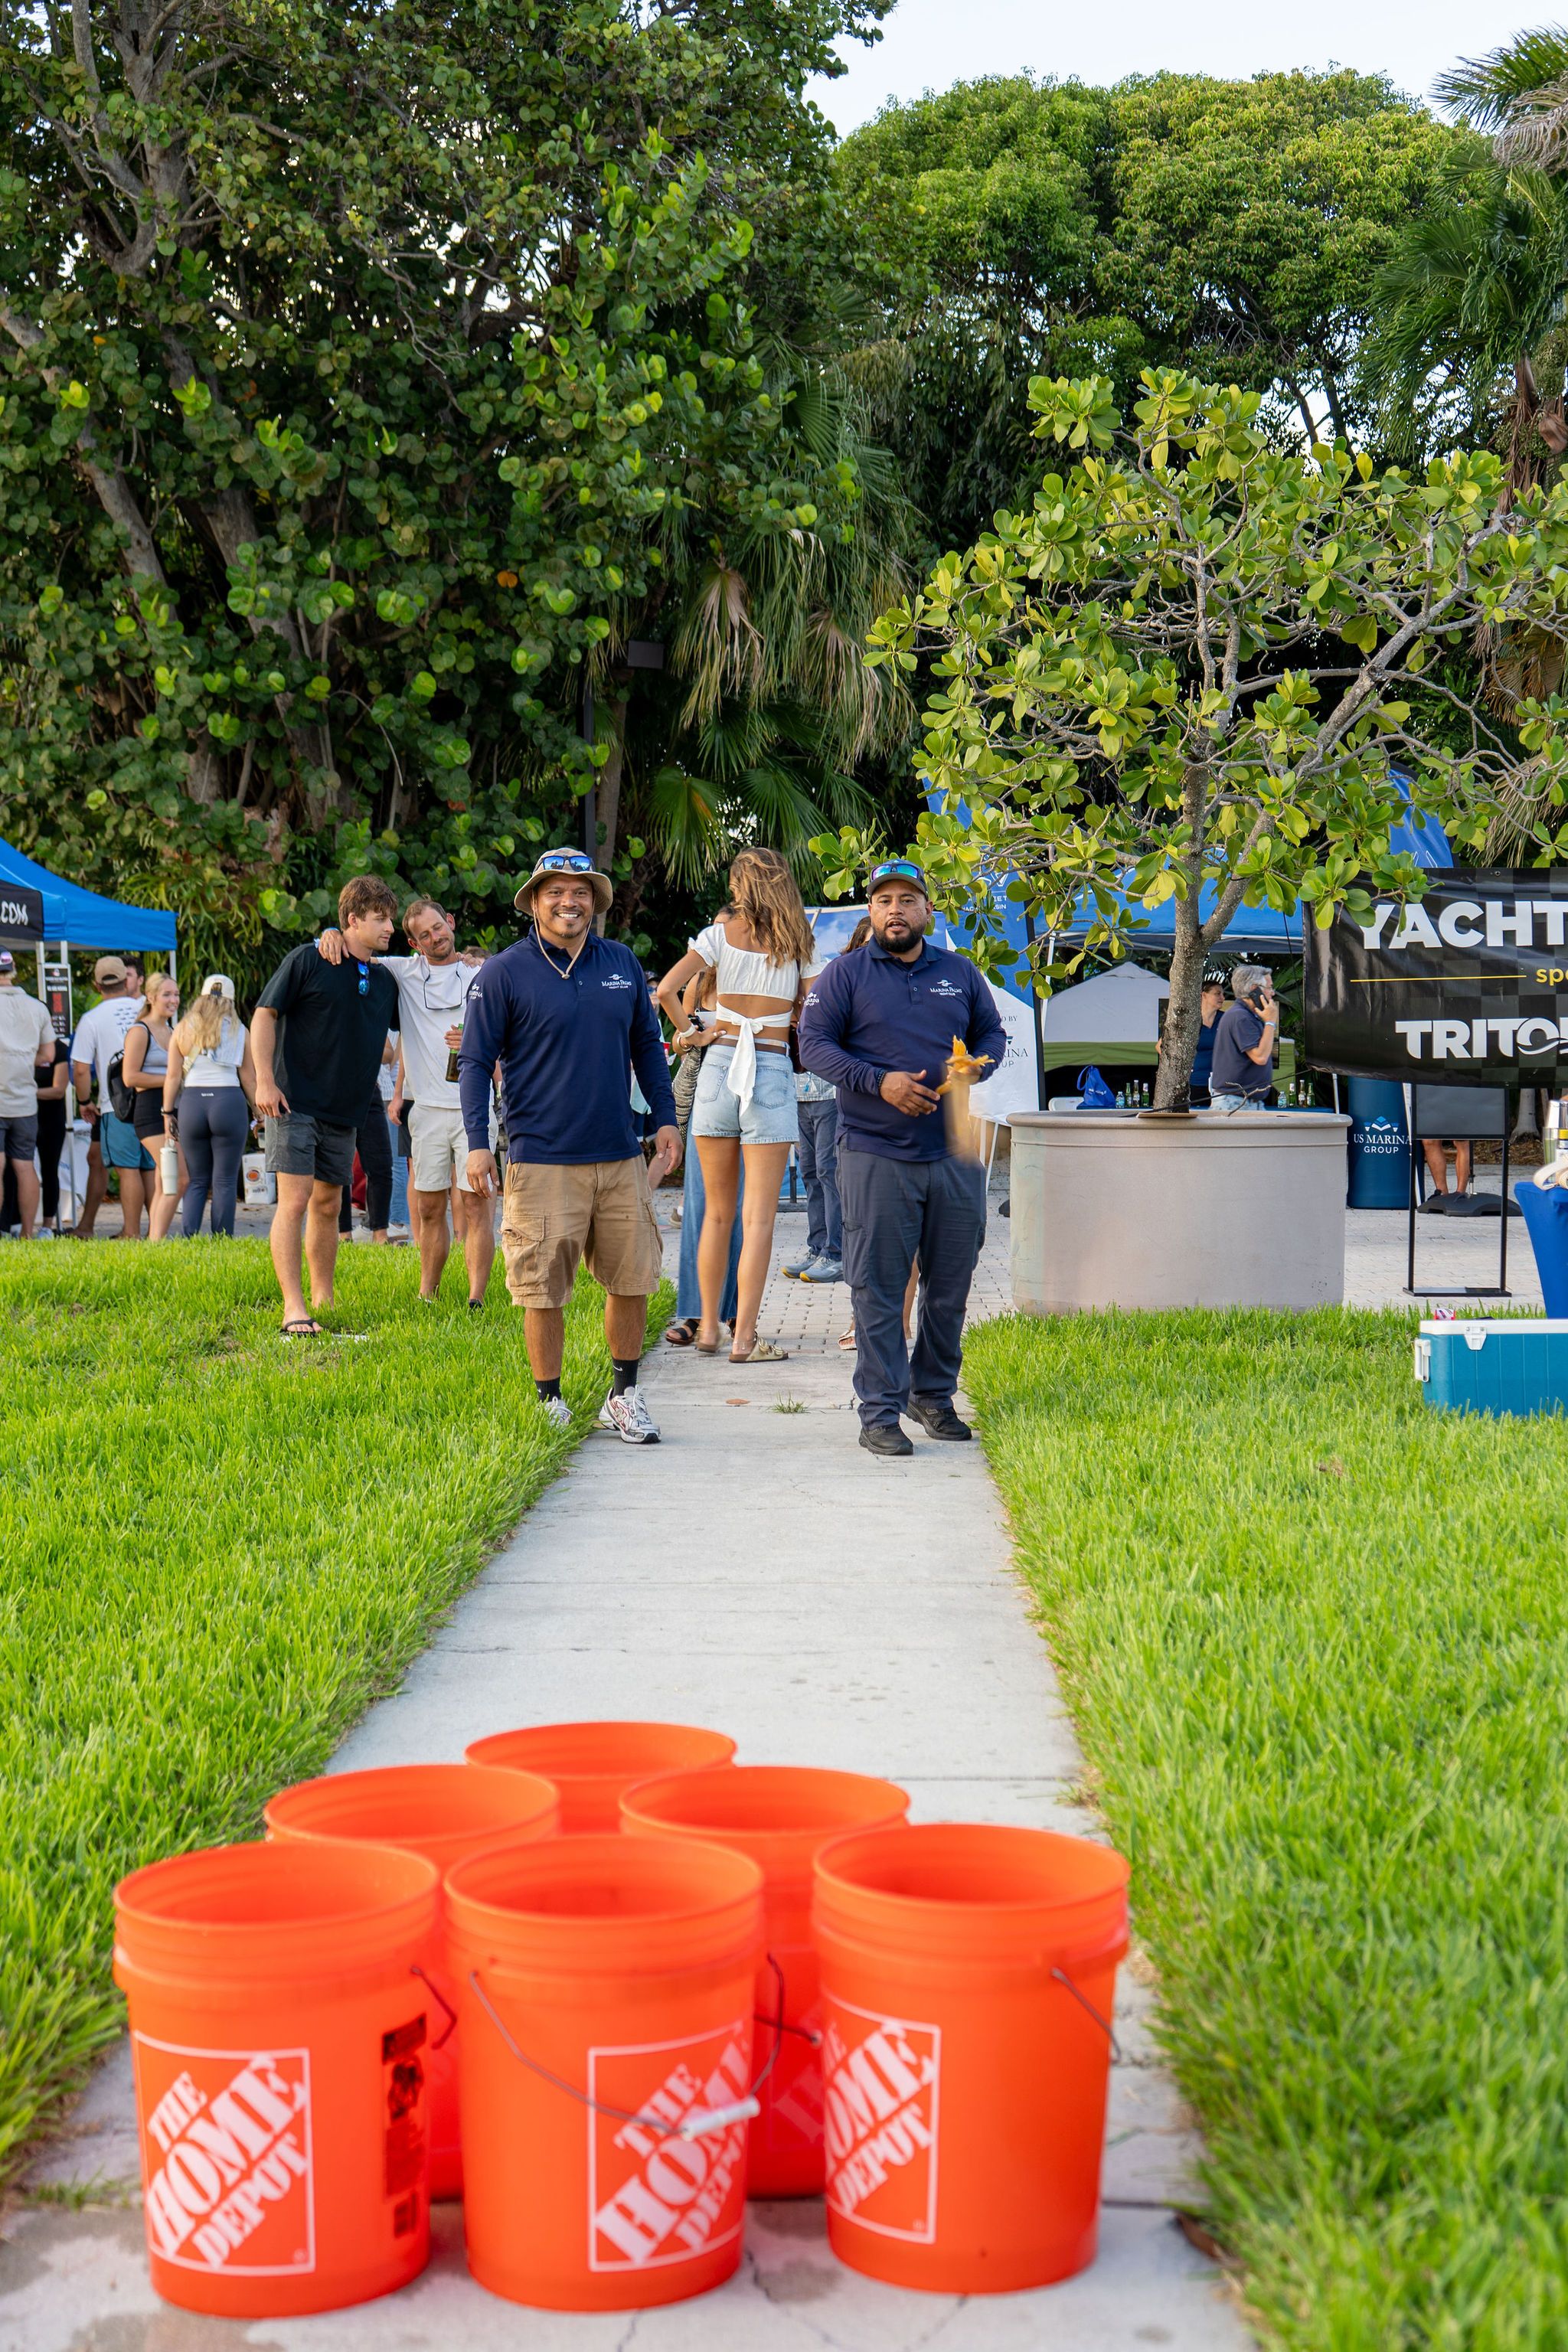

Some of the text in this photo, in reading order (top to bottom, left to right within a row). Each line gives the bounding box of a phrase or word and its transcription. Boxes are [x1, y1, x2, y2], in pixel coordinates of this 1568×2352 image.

[0, 900, 29, 926] COM
[1535, 968, 1568, 986] sp
[1395, 1016, 1568, 1060] TRITO
[1354, 1134, 1364, 1143] US
[148, 2071, 207, 2153] THE
[613, 2063, 703, 2159] THE
[146, 2053, 306, 2256] HOME
[833, 2102, 932, 2214] DEPOT
[192, 2132, 308, 2270] DEPOT
